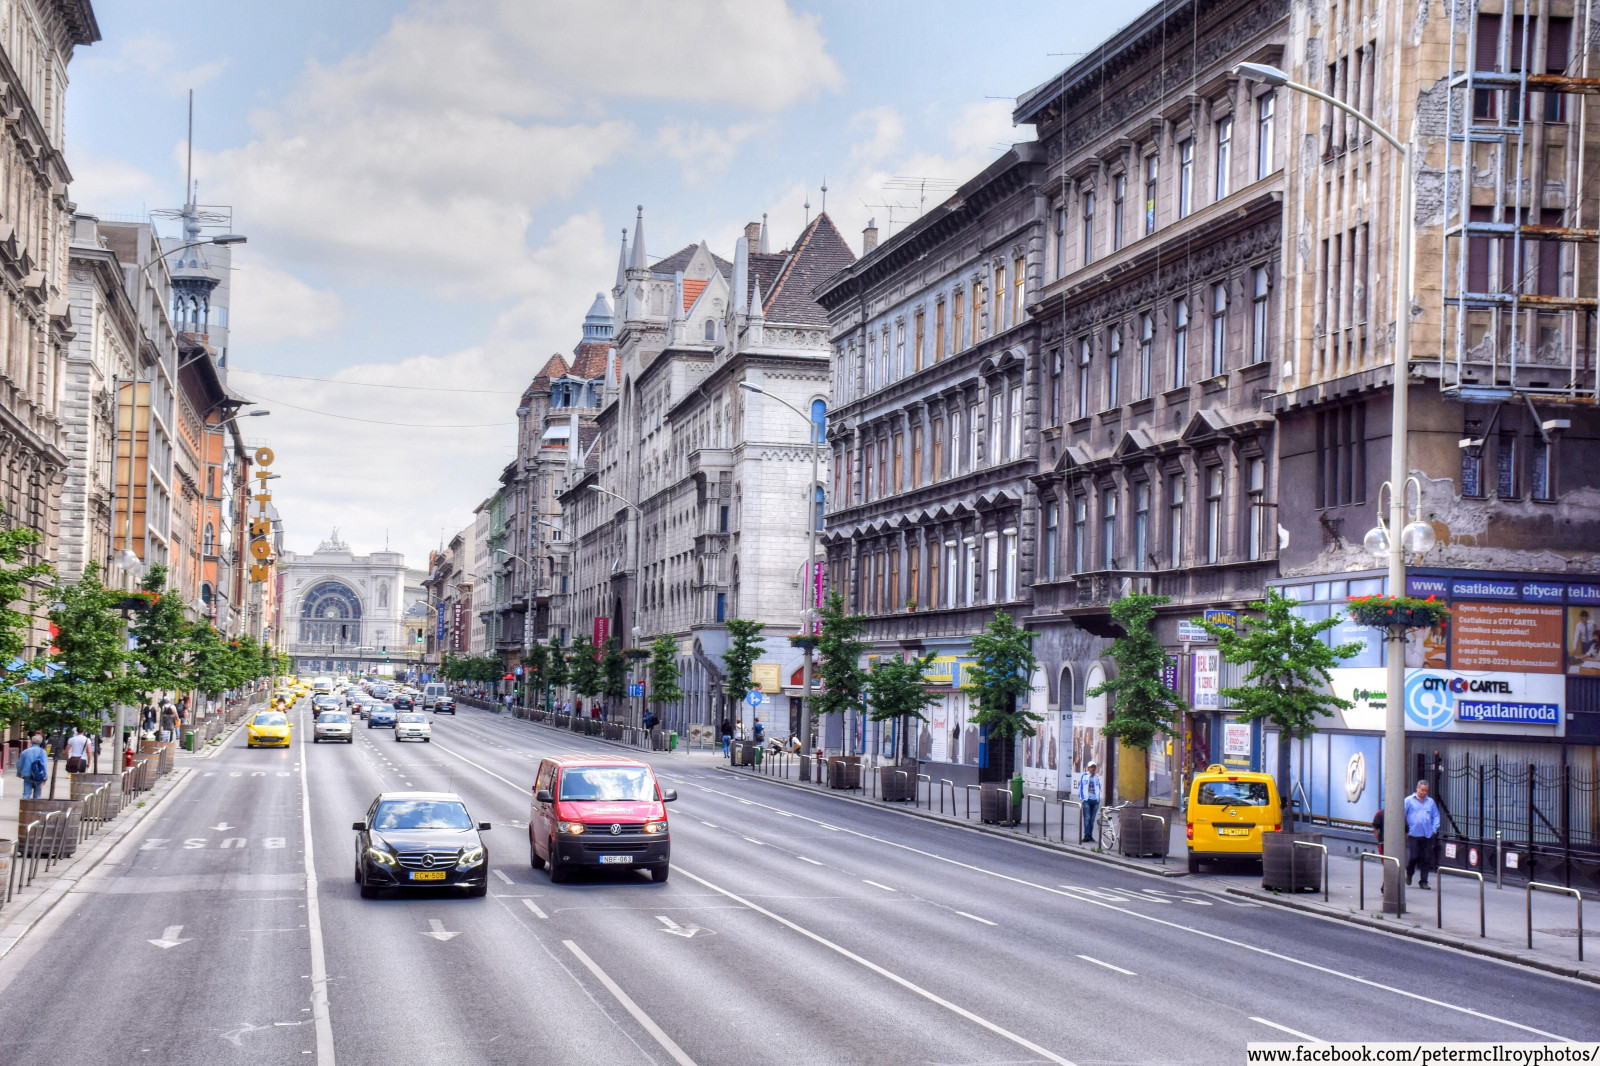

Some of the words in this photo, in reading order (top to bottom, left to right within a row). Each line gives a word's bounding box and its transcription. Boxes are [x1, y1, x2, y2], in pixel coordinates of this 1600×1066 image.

[250, 447, 275, 582] OTTHON
[1412, 581, 1446, 591] www.
[1453, 582, 1517, 595] csatlakozz.
[1459, 605, 1479, 614] Gyere,
[1480, 606, 1503, 614] dolgozz
[1207, 612, 1236, 628] CHANGE
[1459, 616, 1492, 625] Csatlakozz
[1423, 677, 1449, 691] CITY
[1470, 679, 1513, 694] CARTEL
[1460, 702, 1556, 720] ingatlaniroda
